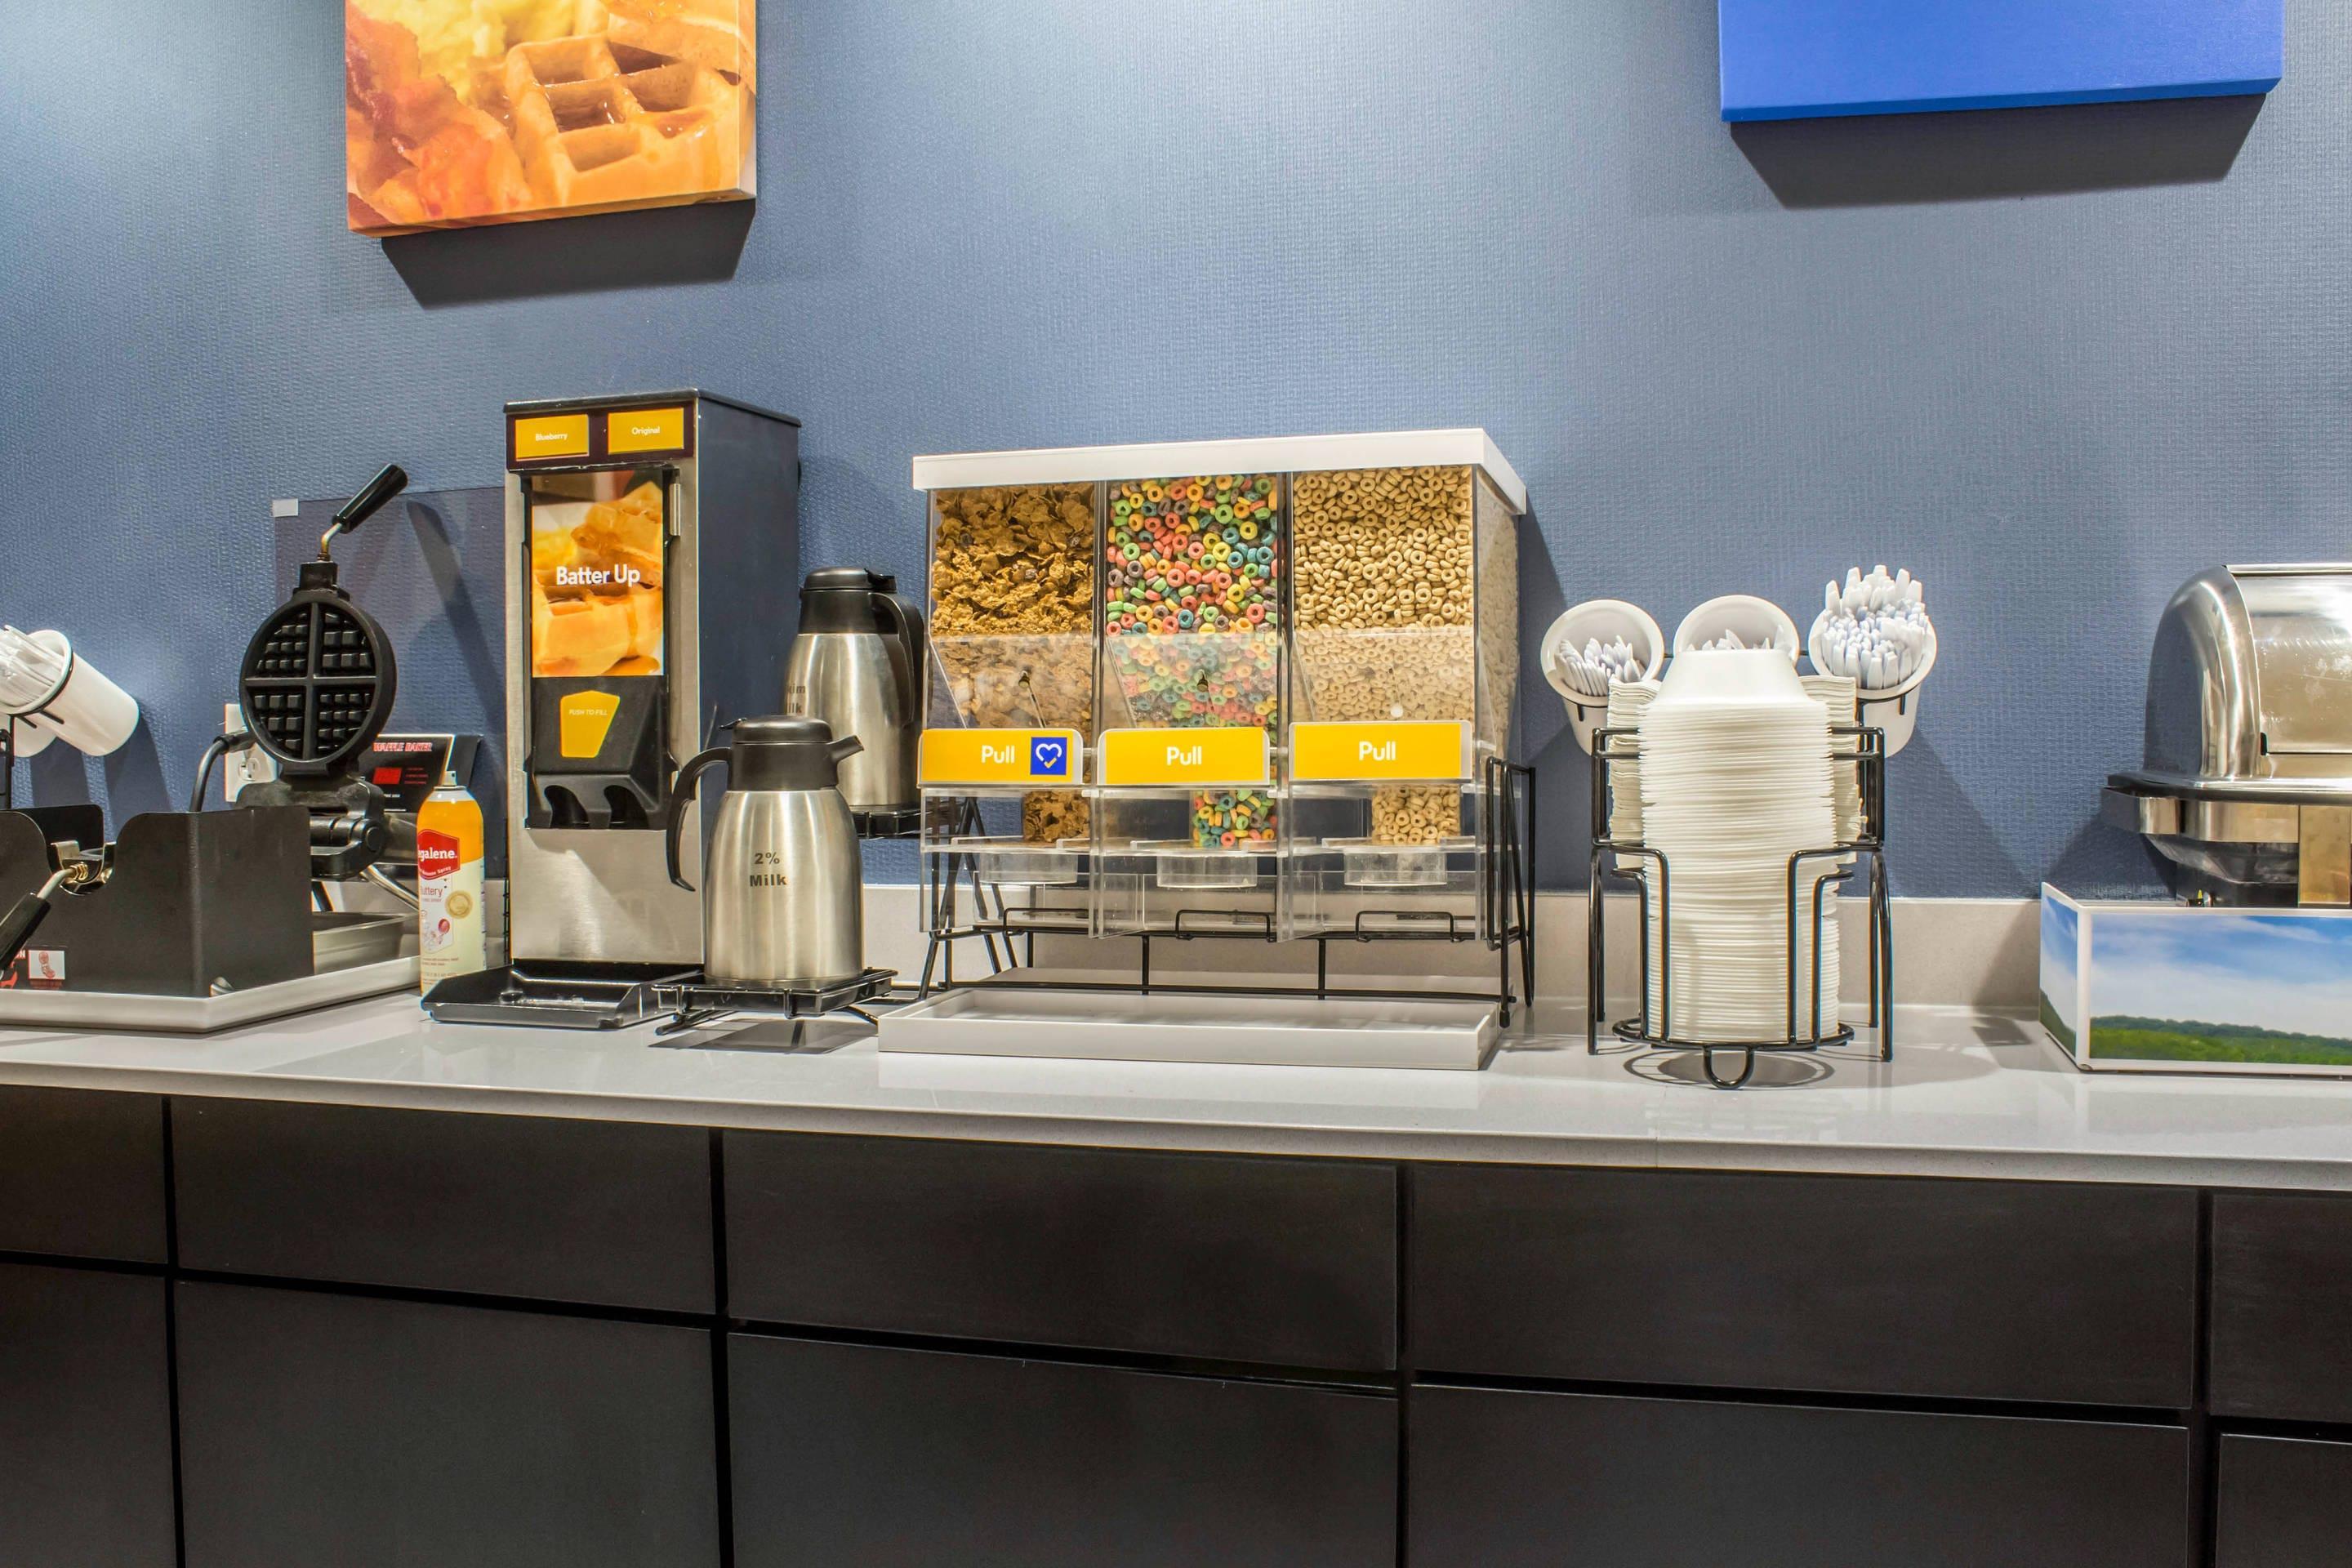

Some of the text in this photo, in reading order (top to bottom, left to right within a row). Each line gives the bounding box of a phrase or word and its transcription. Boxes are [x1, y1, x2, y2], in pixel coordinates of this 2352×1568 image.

[535, 432, 568, 442] Blueberry
[631, 426, 661, 436] Original
[556, 564, 640, 587] Batter Up
[981, 745, 1015, 764] Pull
[1166, 746, 1202, 766] Pull
[1359, 741, 1396, 761] Pull
[755, 852, 780, 865] 2%
[750, 874, 786, 887] Milk
